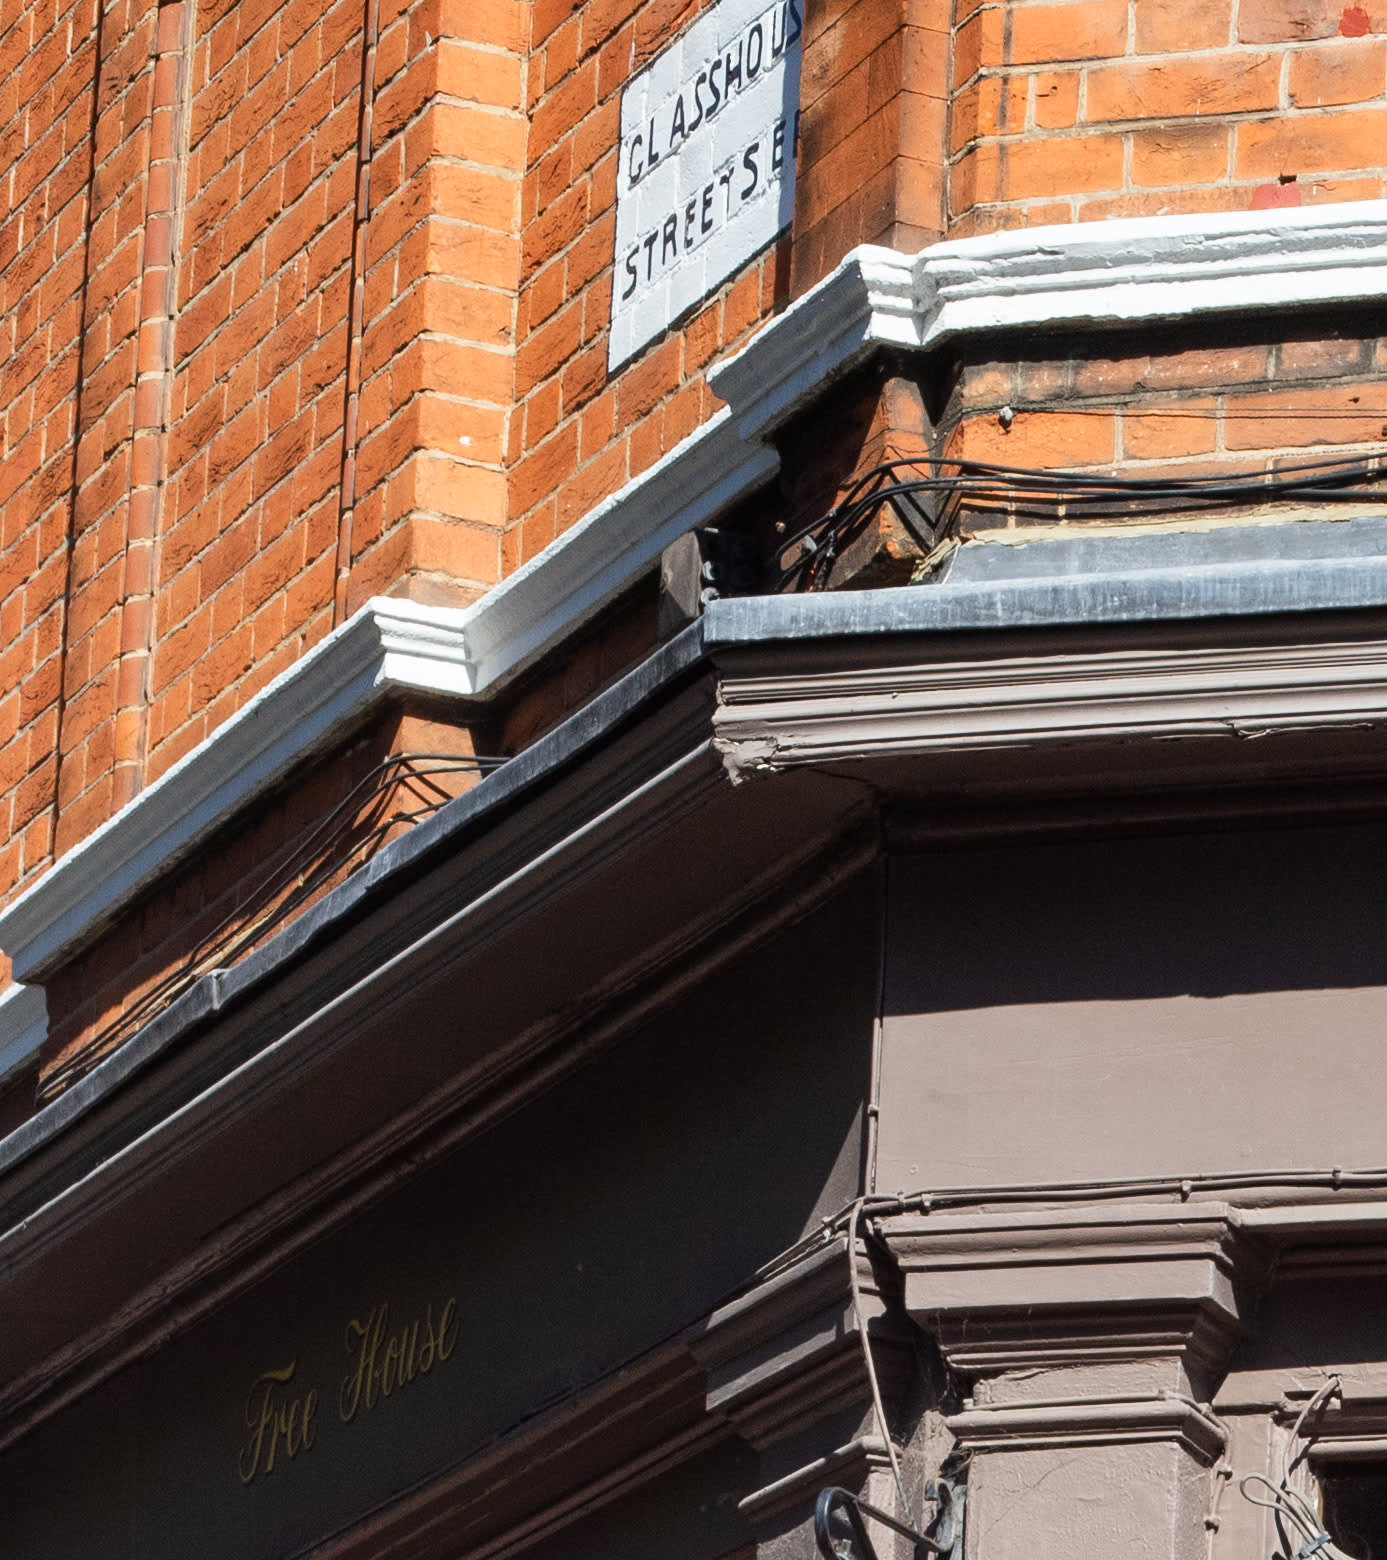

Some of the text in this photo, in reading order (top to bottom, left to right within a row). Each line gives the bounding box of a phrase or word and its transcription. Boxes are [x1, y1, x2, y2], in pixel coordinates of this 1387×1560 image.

[628, 0, 802, 187] GLASSHOUS
[621, 164, 735, 303] STREET
[238, 1296, 457, 1486] Free House
